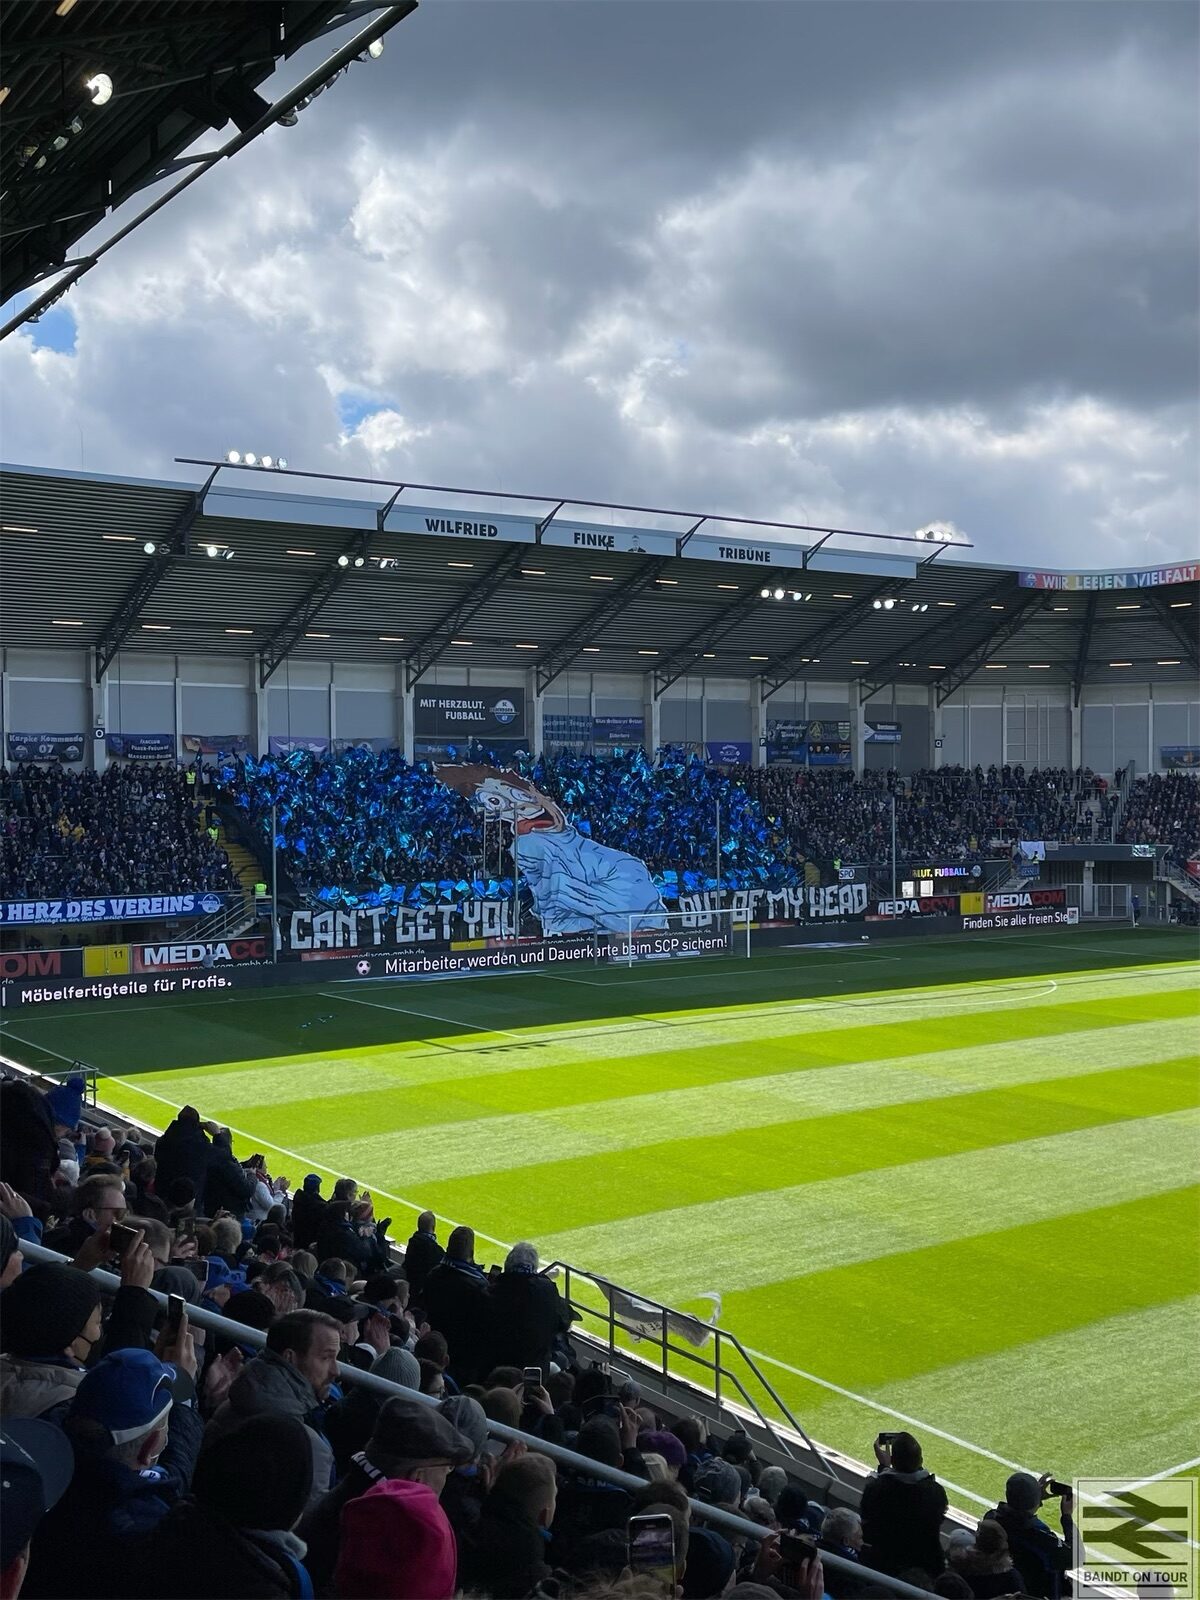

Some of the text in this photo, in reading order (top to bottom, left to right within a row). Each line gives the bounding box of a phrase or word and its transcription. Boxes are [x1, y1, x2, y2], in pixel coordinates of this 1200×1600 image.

[425, 518, 771, 563] WILFRIED FINKE TRIBÜNE
[1042, 566, 1197, 590] WIR LEBEN VIELFALT
[420, 699, 437, 708] MIT
[438, 699, 486, 710] HERZBLUT.
[38, 745, 54, 754] 07
[8, 902, 62, 920] HERZ
[66, 900, 106, 918] DES
[110, 895, 194, 915] VEREINS
[679, 883, 869, 928] OUT OF MY HEAD
[290, 906, 388, 950] CAN'T
[395, 904, 457, 944] GET
[462, 900, 521, 940] YOU
[963, 917, 993, 930] Finden
[994, 915, 1009, 928] Sie
[1010, 914, 1027, 926] alle
[1028, 913, 1052, 926] freien
[113, 950, 124, 959] 11
[385, 955, 462, 974] Mitarbeiter
[466, 952, 516, 968] werden
[520, 947, 544, 964] und
[548, 941, 618, 962] Dauerkarte
[622, 940, 651, 956] beim
[654, 938, 679, 953] SCP
[682, 935, 728, 951] sichern!
[22, 975, 232, 1004] Möbelfertigteile für Profis.
